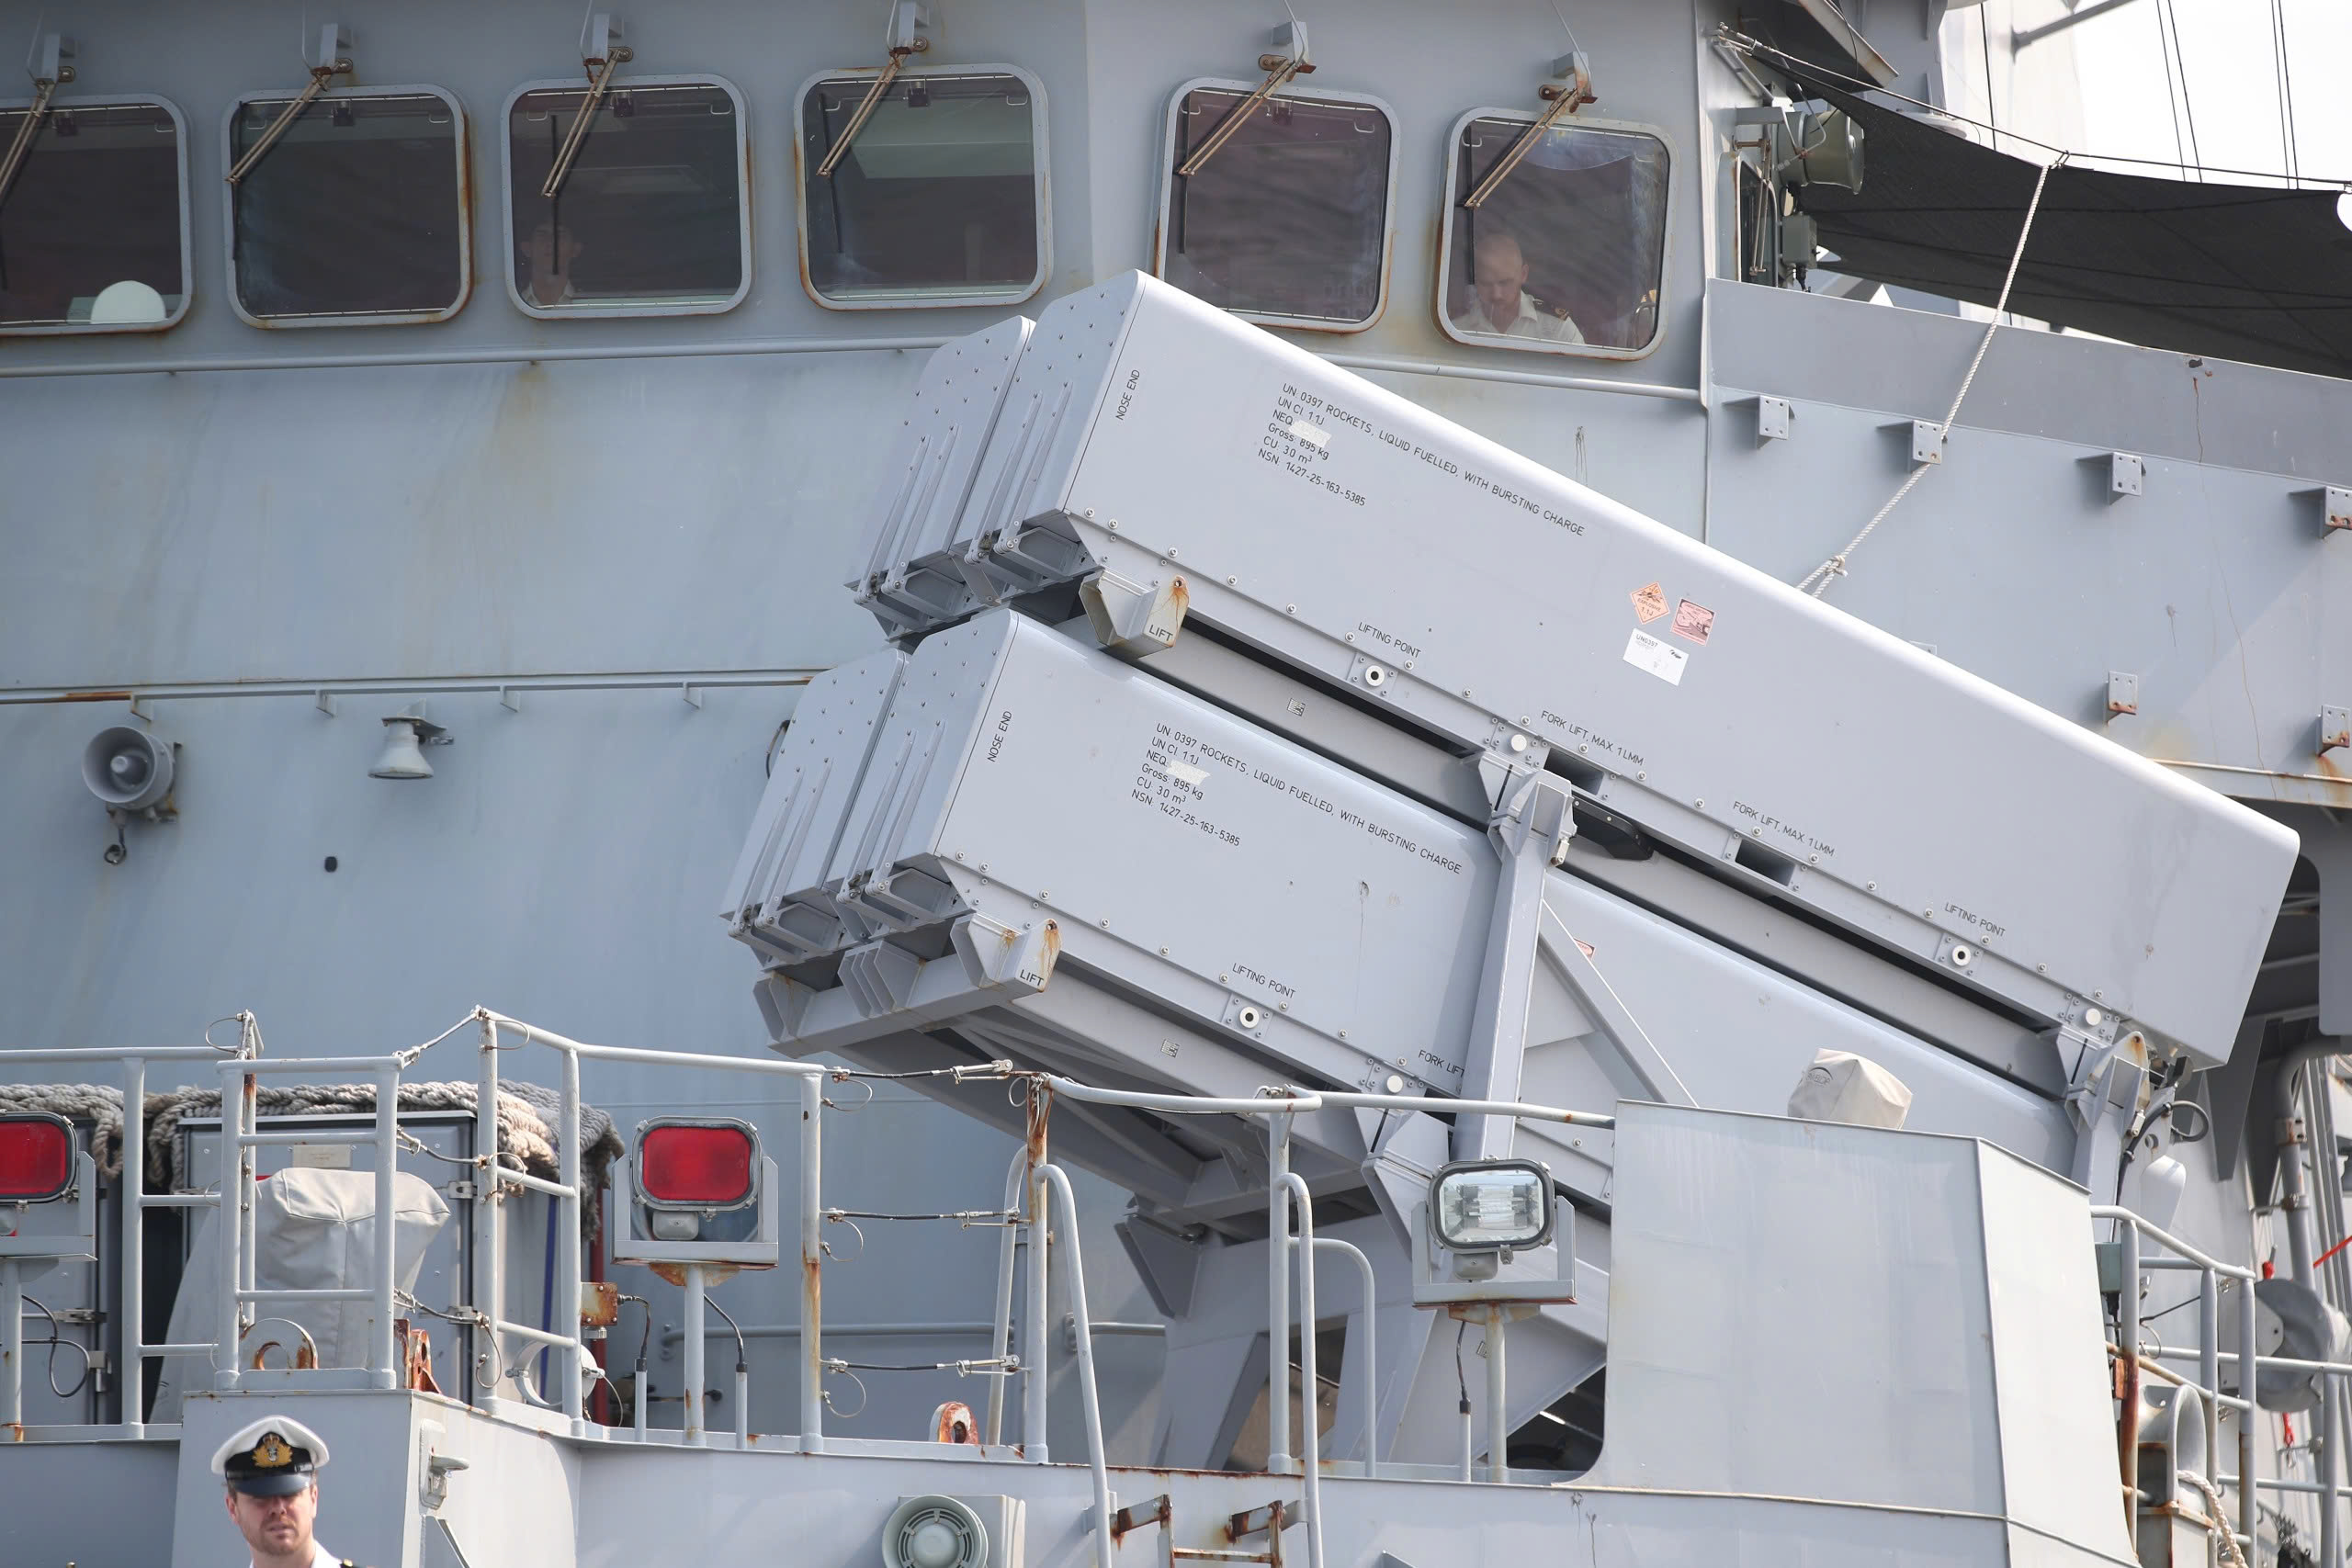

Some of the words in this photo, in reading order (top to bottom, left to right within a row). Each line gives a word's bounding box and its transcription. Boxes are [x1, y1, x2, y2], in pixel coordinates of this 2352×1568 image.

[1115, 392, 1132, 421] NOSE
[1126, 369, 1140, 390] END
[1278, 396, 1292, 410] UN
[1268, 423, 1296, 442] Gross:
[1299, 438, 1316, 453] 895
[1317, 447, 1329, 461] kg
[1258, 448, 1281, 466] NSN:
[1285, 461, 1366, 506] 1427-25-163-5385
[1300, 392, 1323, 409] 0397
[1326, 404, 1374, 436] ROCKETS,
[1379, 430, 1410, 452] LIQUID
[1414, 447, 1458, 477] FUELLED,
[1464, 471, 1489, 490] WITH
[1491, 485, 1539, 513] BURSTING
[1544, 510, 1585, 536] CHARGE
[1148, 625, 1173, 641] LIFT
[1358, 622, 1392, 644] LIFTING
[1394, 639, 1421, 659] POINT
[987, 733, 1004, 762] NOSE
[998, 711, 1012, 732] END
[1541, 710, 1567, 729] FORK
[1151, 736, 1165, 750] UN
[1142, 763, 1170, 783] Gross:
[1173, 778, 1191, 793] 895
[1192, 786, 1204, 801] kg
[1131, 788, 1154, 807] NSN:
[1159, 802, 1240, 847] 1427-25-163-5385
[1174, 732, 1197, 749] 0397
[1200, 744, 1249, 775] ROCKETS,
[1253, 770, 1285, 791] LIQUID
[1288, 785, 1334, 816] FUELLED,
[1340, 809, 1365, 829] WITH
[1367, 823, 1417, 852] BURSTING
[1419, 848, 1462, 874] CHARGE
[1733, 801, 1758, 820] FORK
[1944, 902, 1977, 924] LIFTING
[1980, 919, 2006, 937] POINT
[1020, 969, 1044, 986] LIFT
[1232, 963, 1266, 985] LIFTING
[1268, 979, 1296, 998] POINT
[1419, 1050, 1445, 1068] FORK
